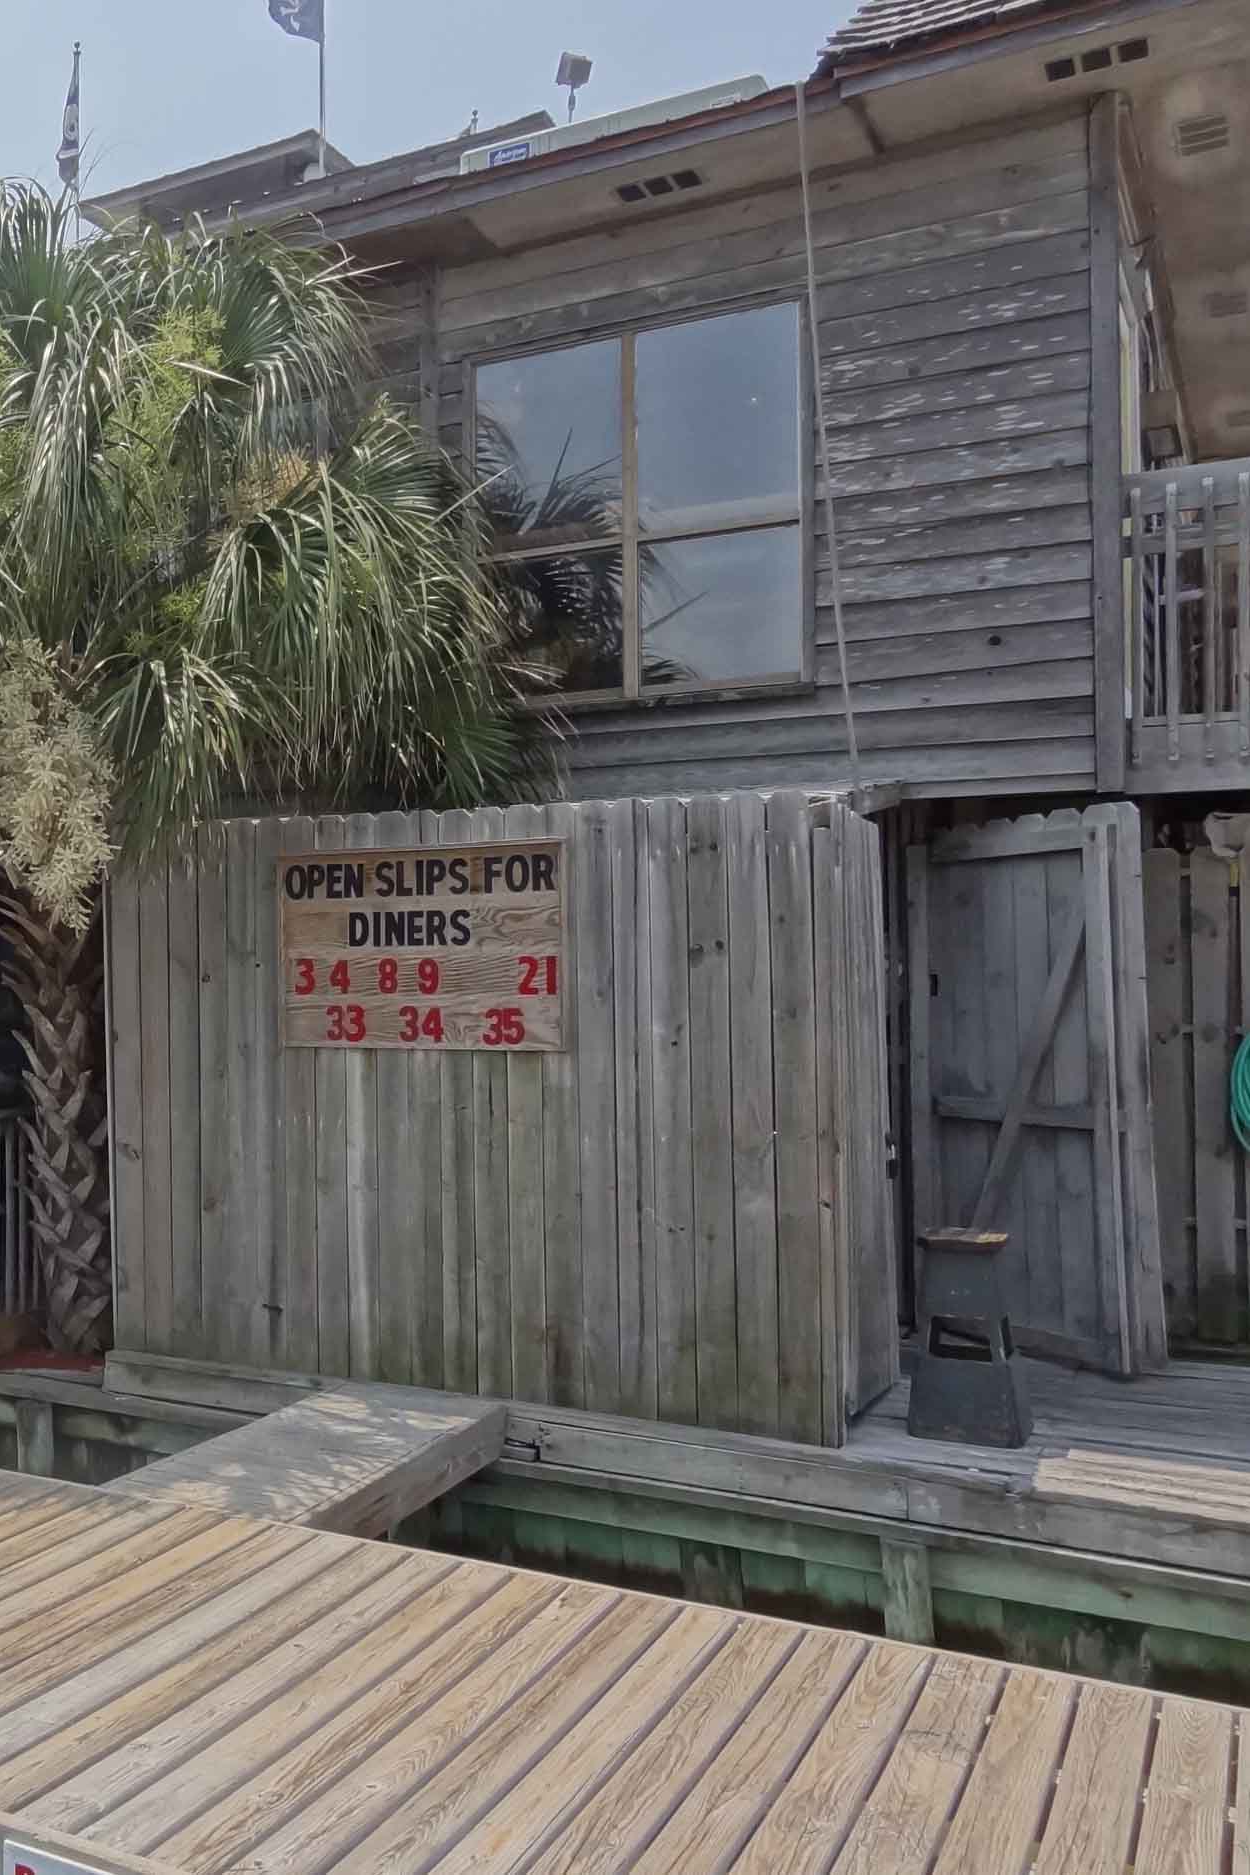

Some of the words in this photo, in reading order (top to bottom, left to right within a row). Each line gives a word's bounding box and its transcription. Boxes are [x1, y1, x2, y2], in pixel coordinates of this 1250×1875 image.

[285, 863, 364, 899] OPEN
[374, 858, 469, 897] SLIPS
[484, 854, 556, 894] FOR
[349, 909, 471, 947] DINERS
[294, 958, 316, 995] 3
[328, 959, 350, 994] 4
[378, 958, 398, 994] 8
[417, 958, 439, 994] 9
[517, 956, 558, 995] 21
[326, 1005, 367, 1042] 33
[399, 1005, 444, 1043] 34
[482, 1007, 525, 1045] 35
